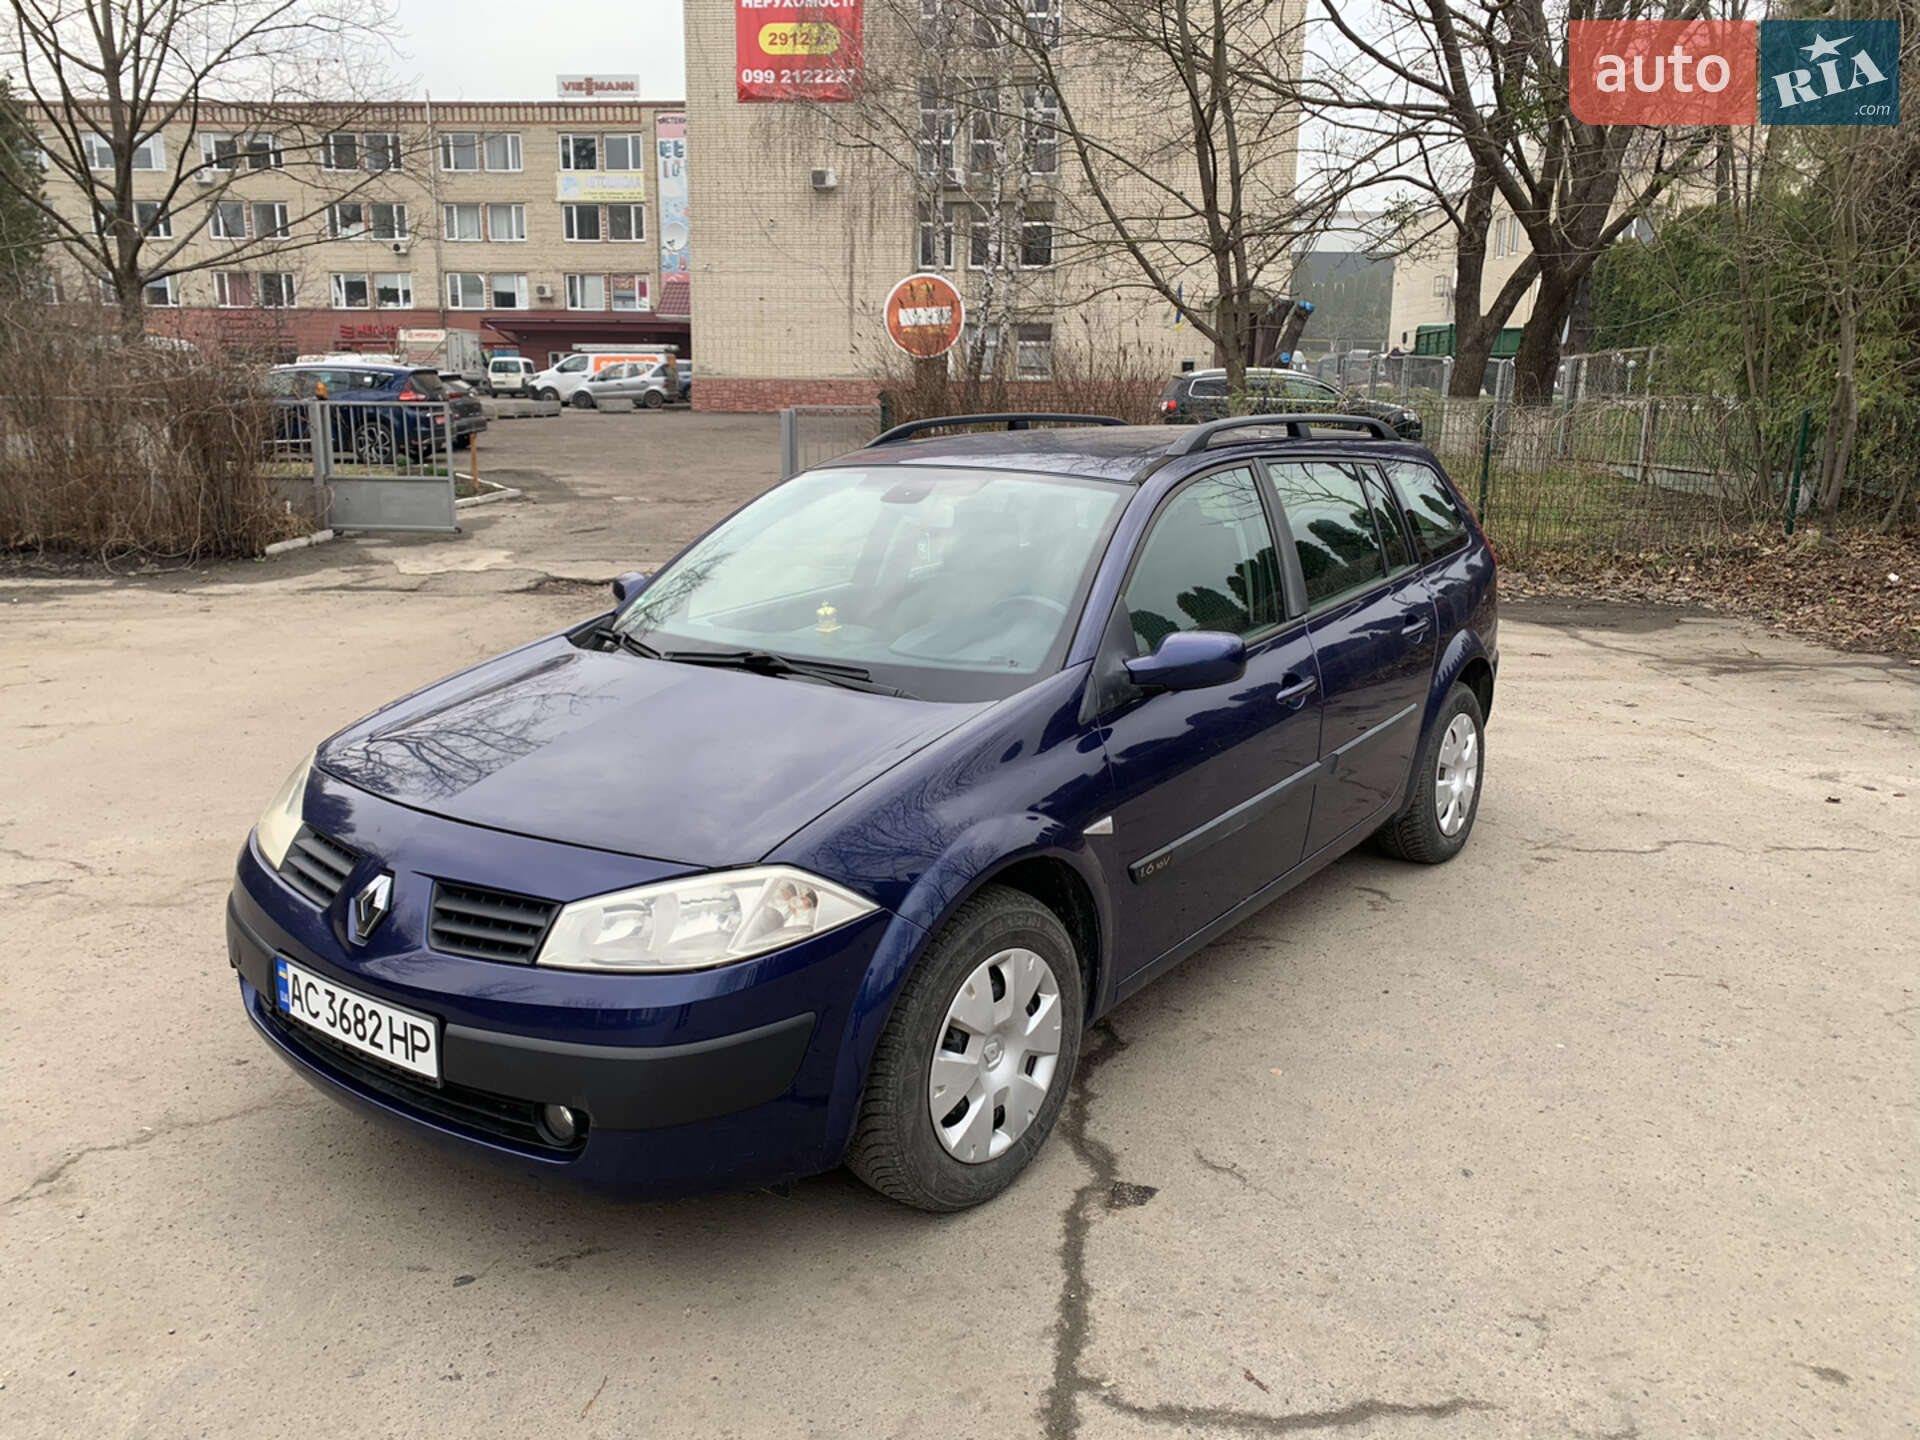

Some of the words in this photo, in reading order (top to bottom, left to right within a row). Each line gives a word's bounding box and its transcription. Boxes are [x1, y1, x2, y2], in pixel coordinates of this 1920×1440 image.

[768, 32, 829, 46] 2912
[742, 68, 776, 84] 099
[291, 973, 320, 1019] AC
[324, 988, 384, 1051] 3682
[388, 1015, 431, 1063] HP
